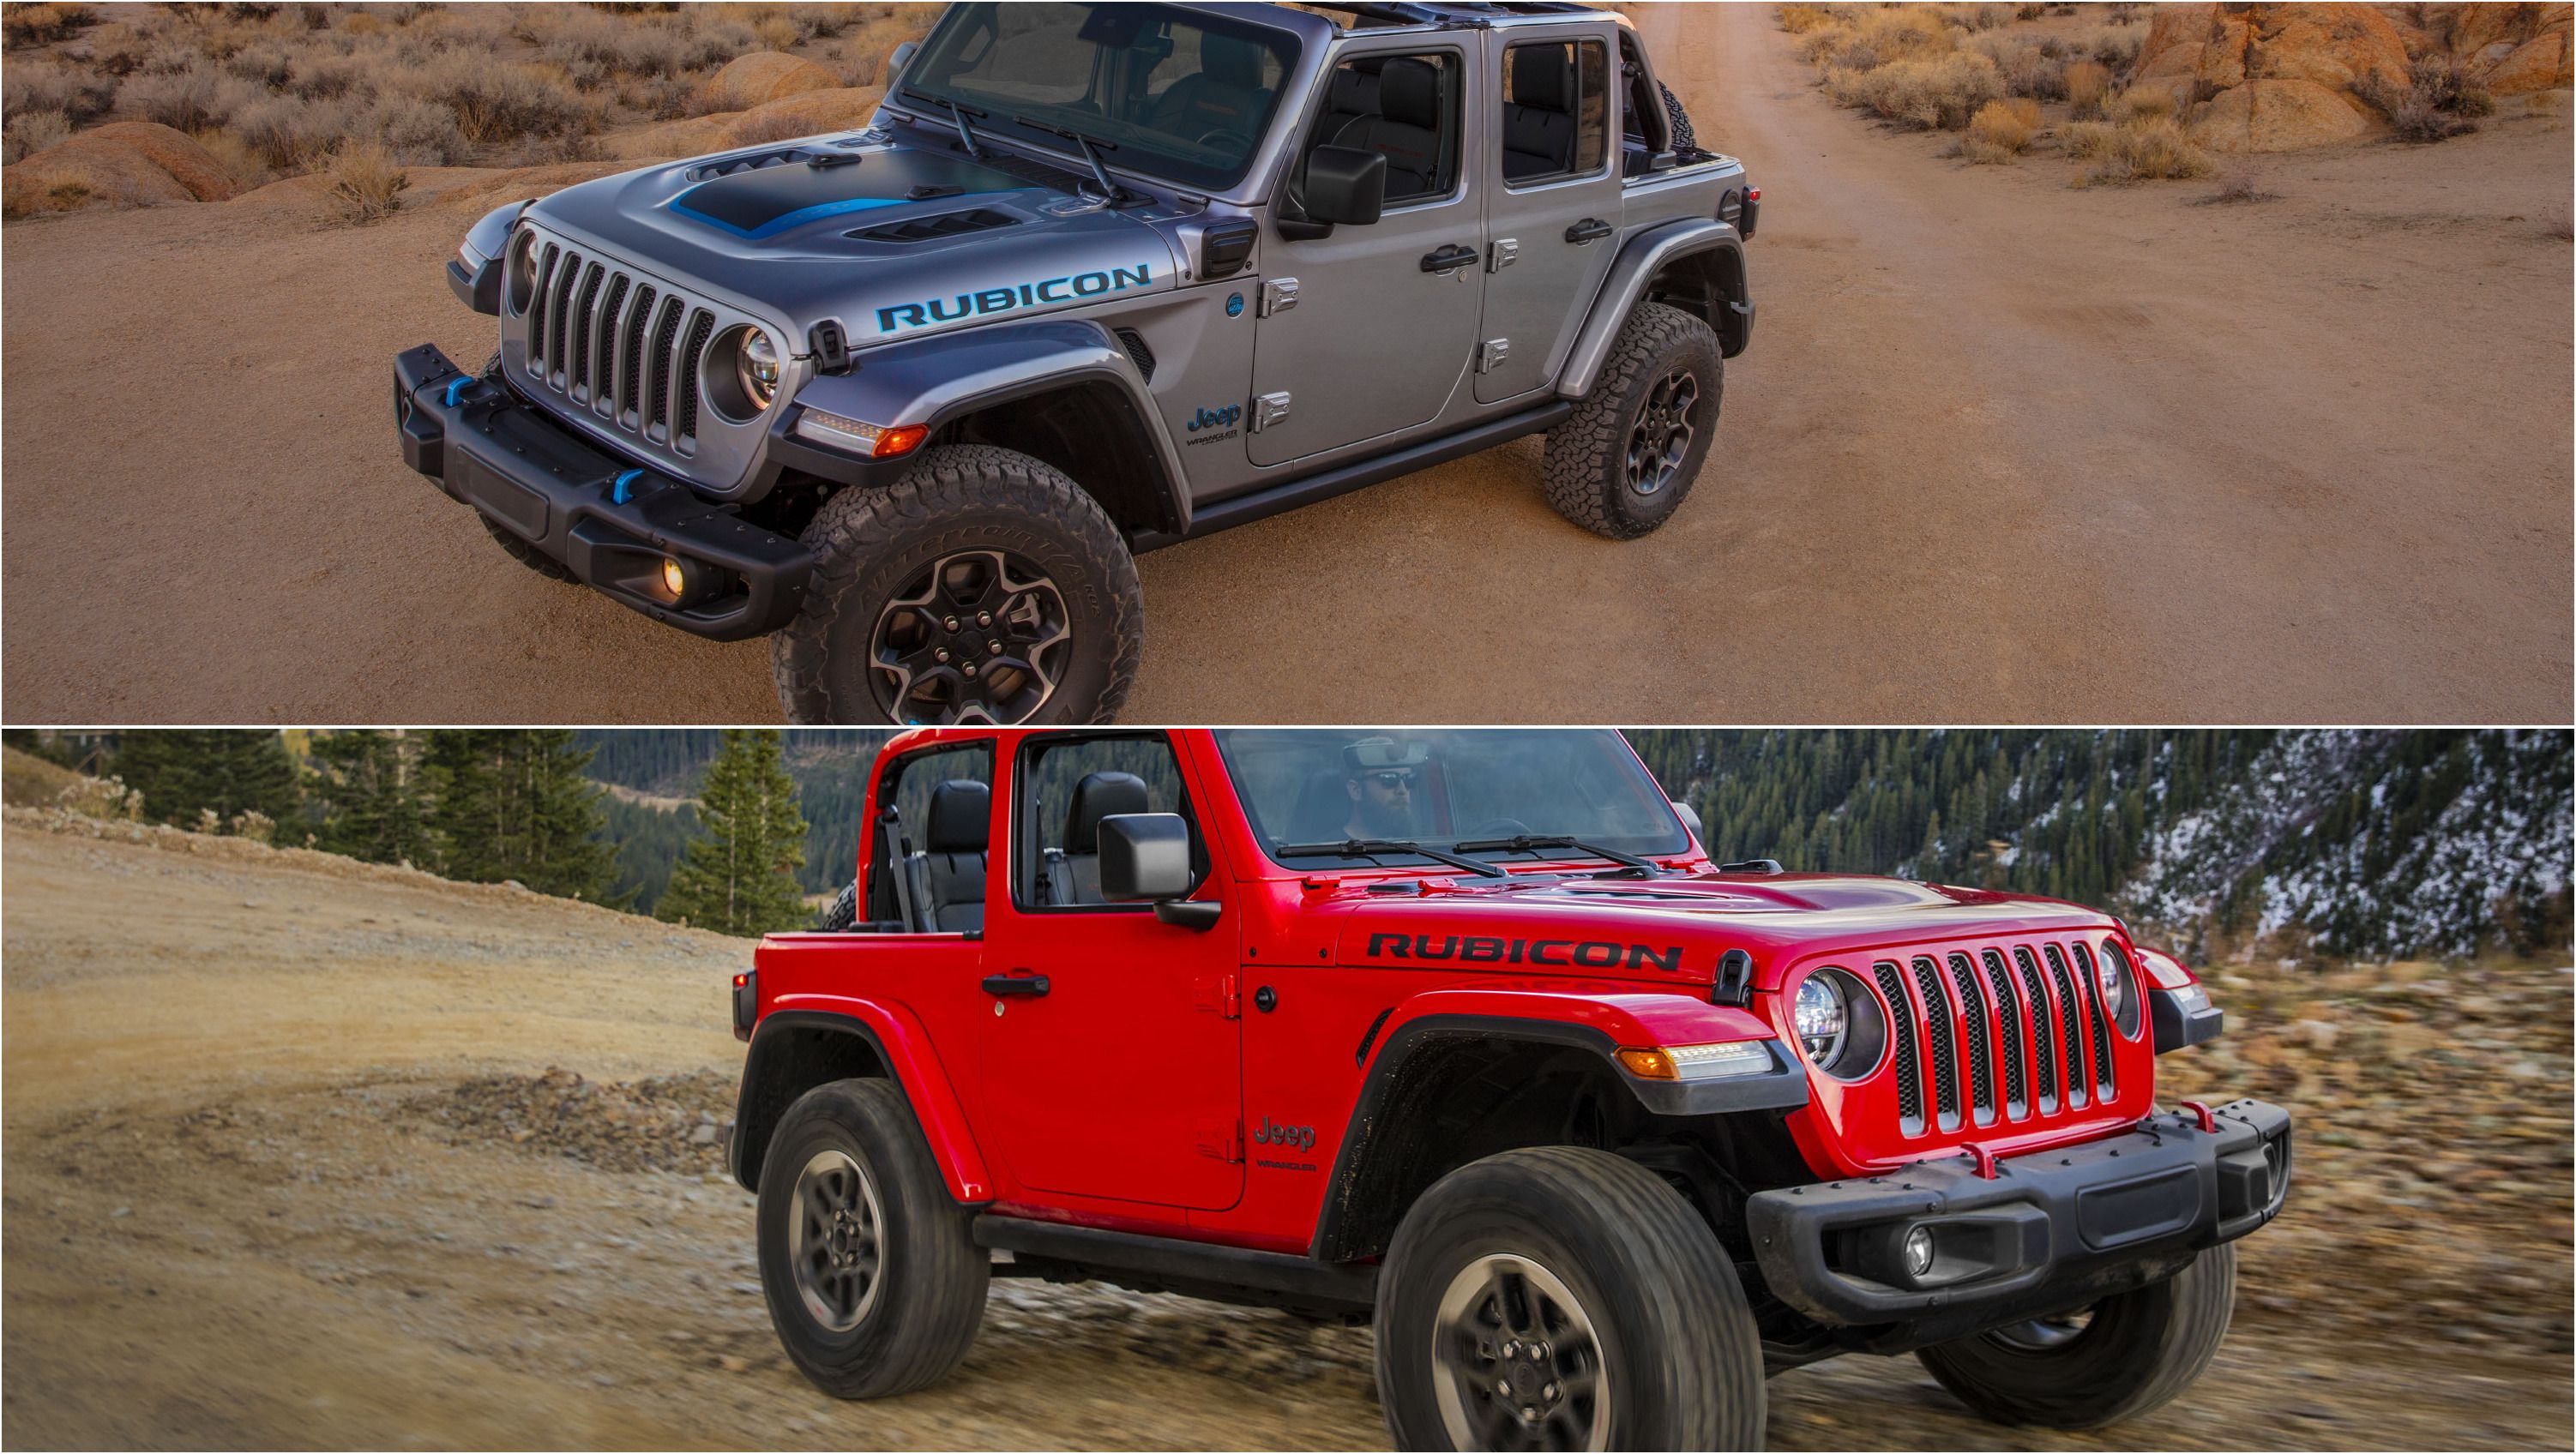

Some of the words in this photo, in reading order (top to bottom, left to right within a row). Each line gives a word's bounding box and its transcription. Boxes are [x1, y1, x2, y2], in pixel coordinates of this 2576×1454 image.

[876, 263, 1153, 333] RUBICON
[1188, 404, 1241, 432] Jeep
[1187, 430, 1237, 446] WRANGLER
[1367, 933, 1683, 971] RUBICON
[1254, 1115, 1315, 1153] Jeep
